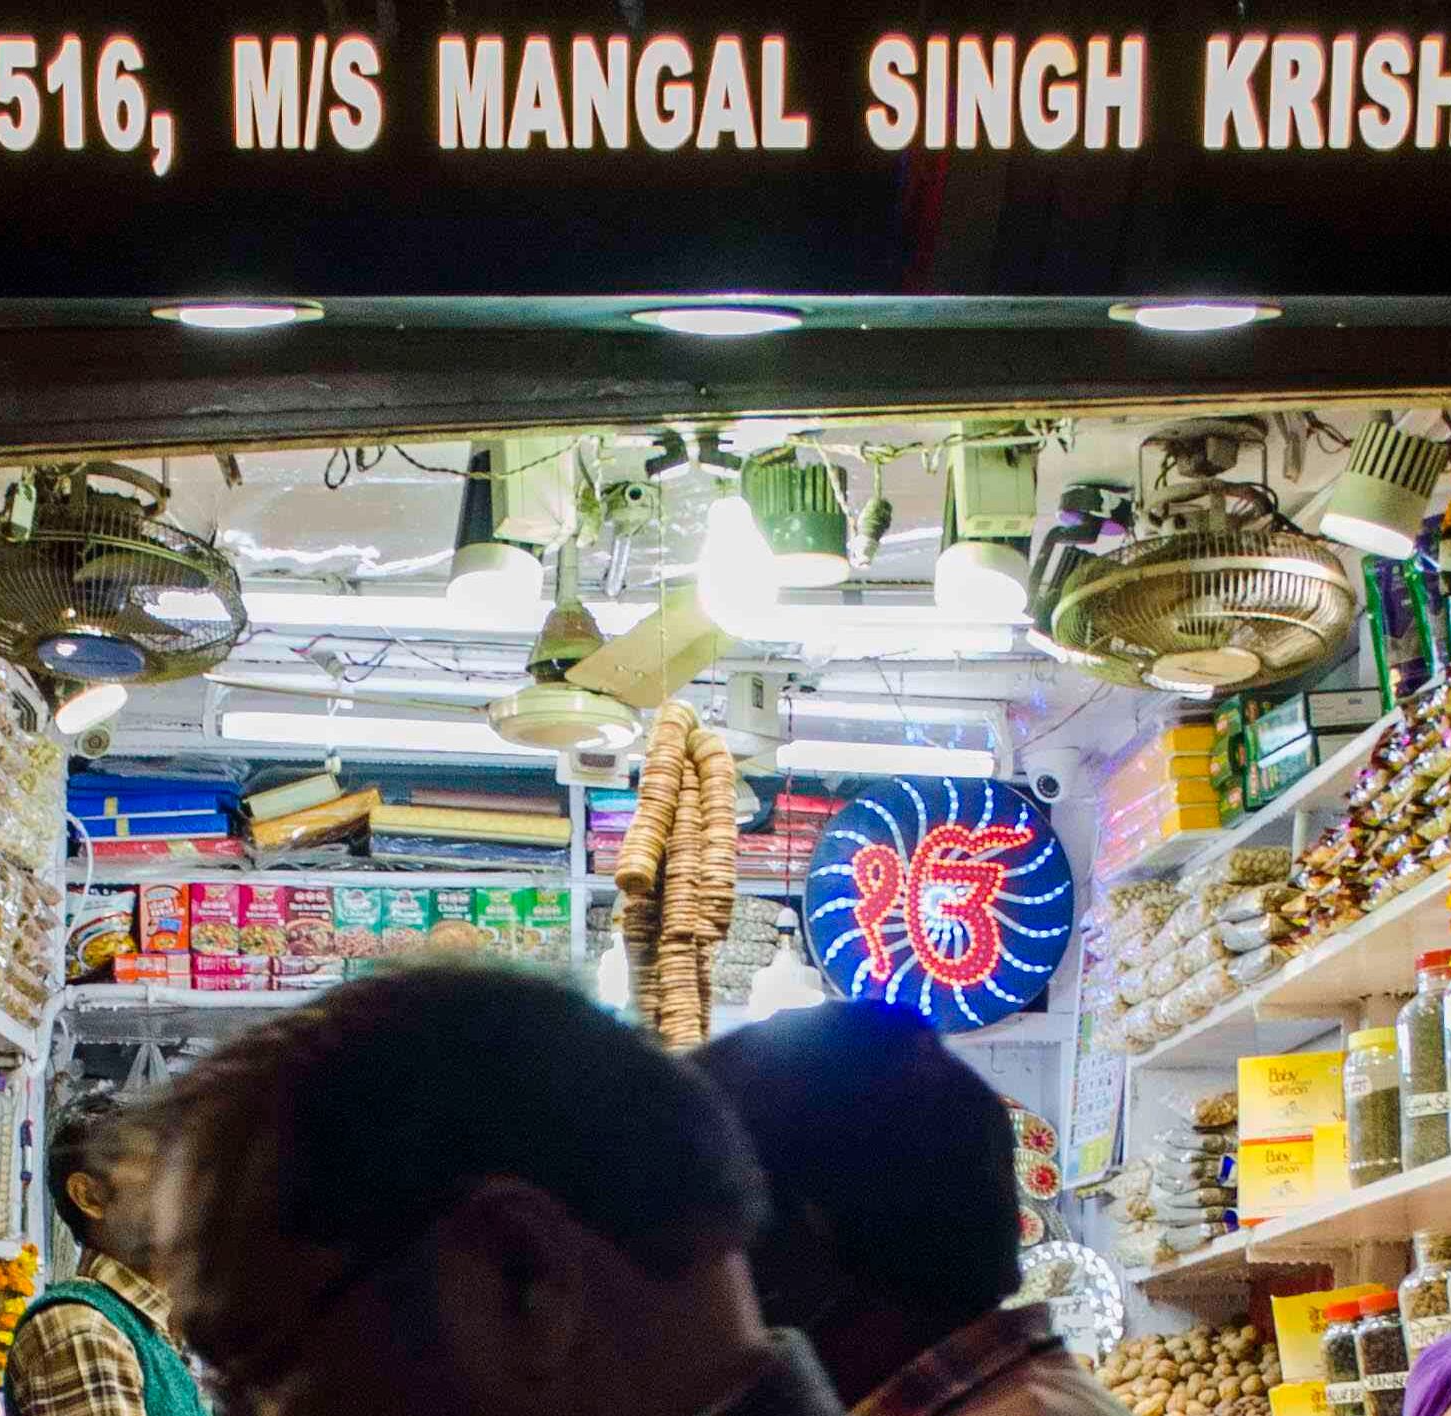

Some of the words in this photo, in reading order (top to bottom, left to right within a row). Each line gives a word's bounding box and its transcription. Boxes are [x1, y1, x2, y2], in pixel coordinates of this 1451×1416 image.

[233, 36, 382, 151] M/S
[437, 35, 809, 150] MANGAL
[864, 35, 1145, 150] SINGH
[1268, 1067, 1299, 1083] Baby
